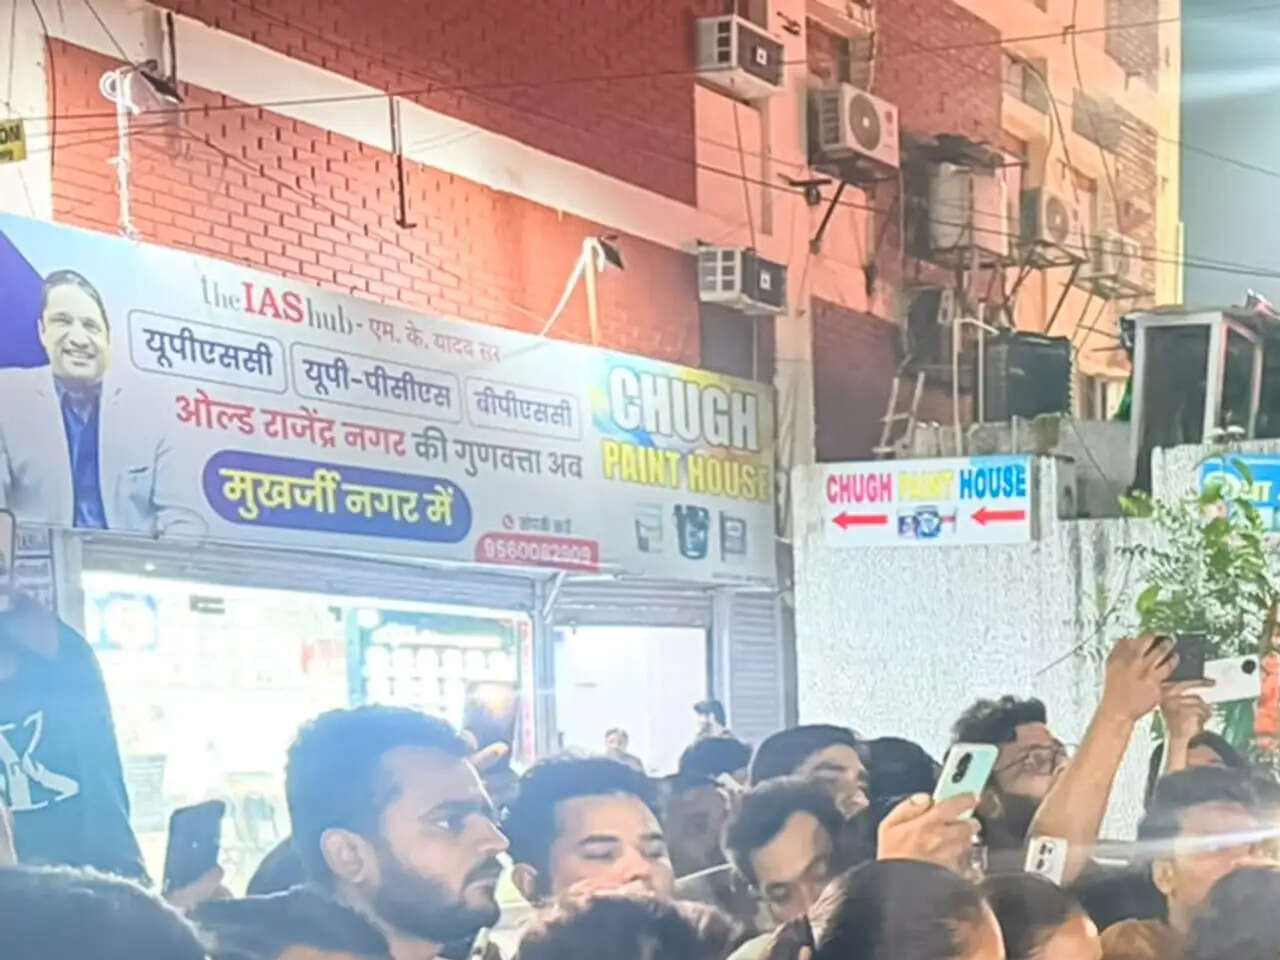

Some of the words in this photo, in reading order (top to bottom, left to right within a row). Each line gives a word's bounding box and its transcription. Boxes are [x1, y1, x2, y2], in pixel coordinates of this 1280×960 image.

[142, 326, 273, 376] यूपीएससी
[176, 388, 255, 435] ओल्ड
[261, 406, 336, 449] राजेंद्र
[342, 421, 406, 456] नगर
[411, 425, 448, 464] की
[454, 439, 542, 477] गुणवत्ता
[609, 365, 760, 452] CHUGH
[602, 438, 682, 489] PAINT
[687, 453, 771, 503] HOUSE
[826, 473, 892, 503] CHUGH
[959, 464, 1027, 500] HOUSE
[342, 484, 419, 523] नगर
[422, 485, 455, 527] में
